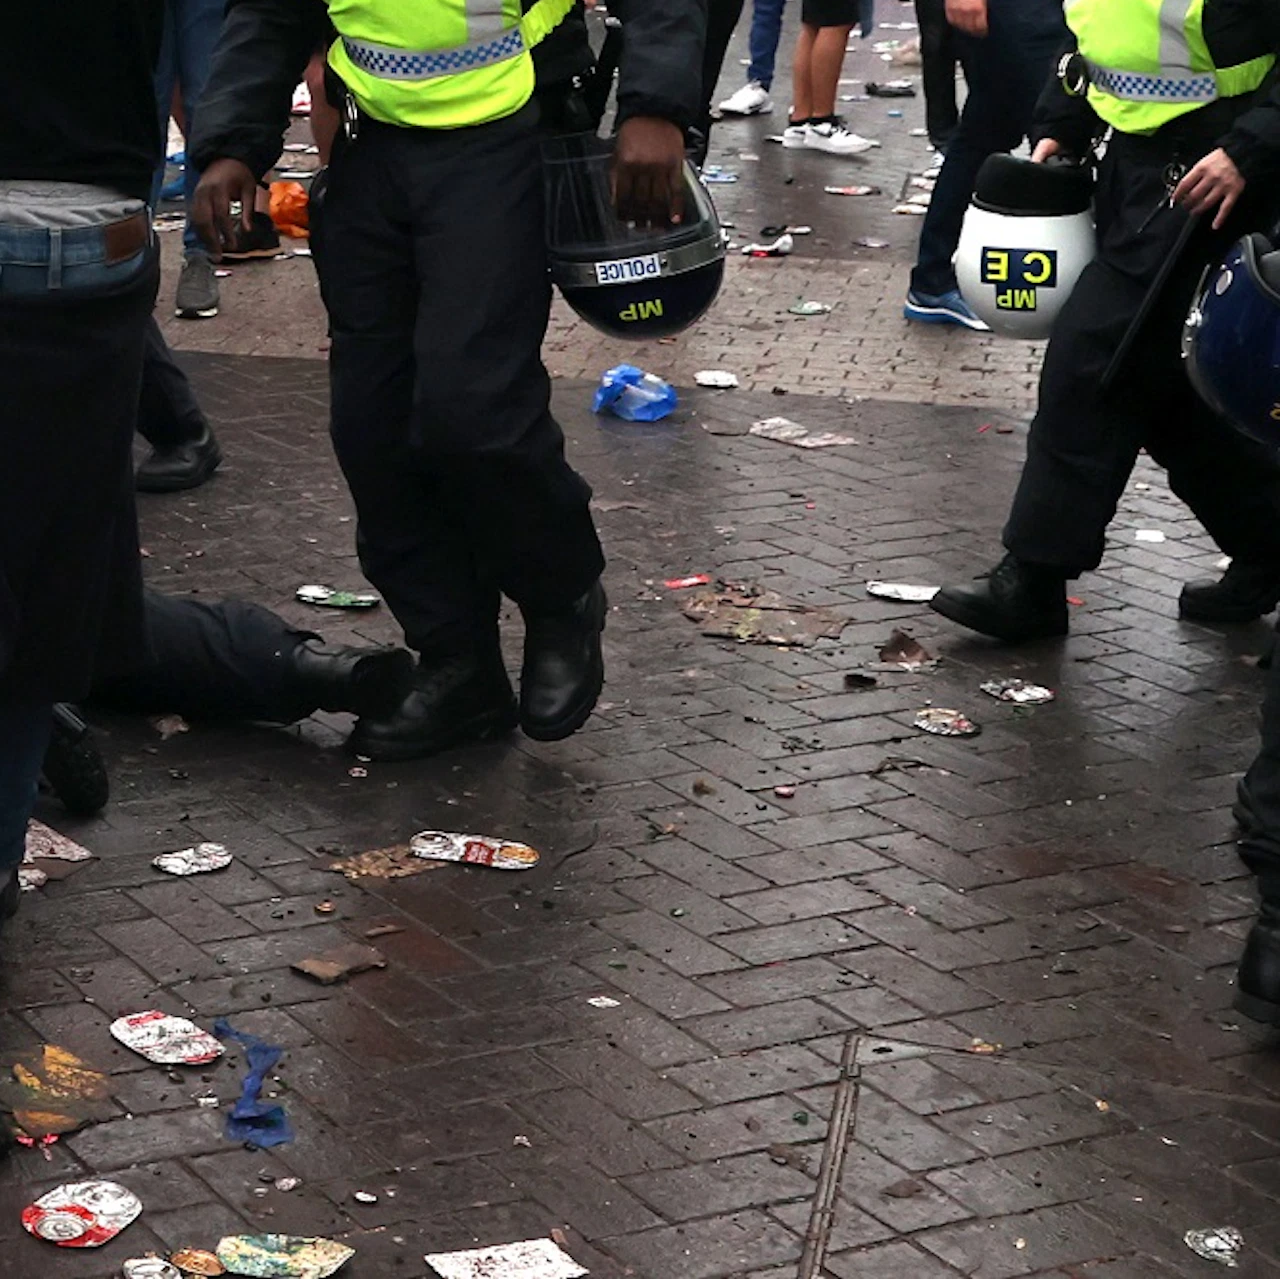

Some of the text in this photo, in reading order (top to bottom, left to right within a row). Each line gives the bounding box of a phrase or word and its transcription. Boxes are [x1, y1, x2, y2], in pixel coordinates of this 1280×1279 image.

[598, 257, 657, 281] POLICE
[619, 298, 663, 321] MP
[997, 289, 1036, 309] MP
